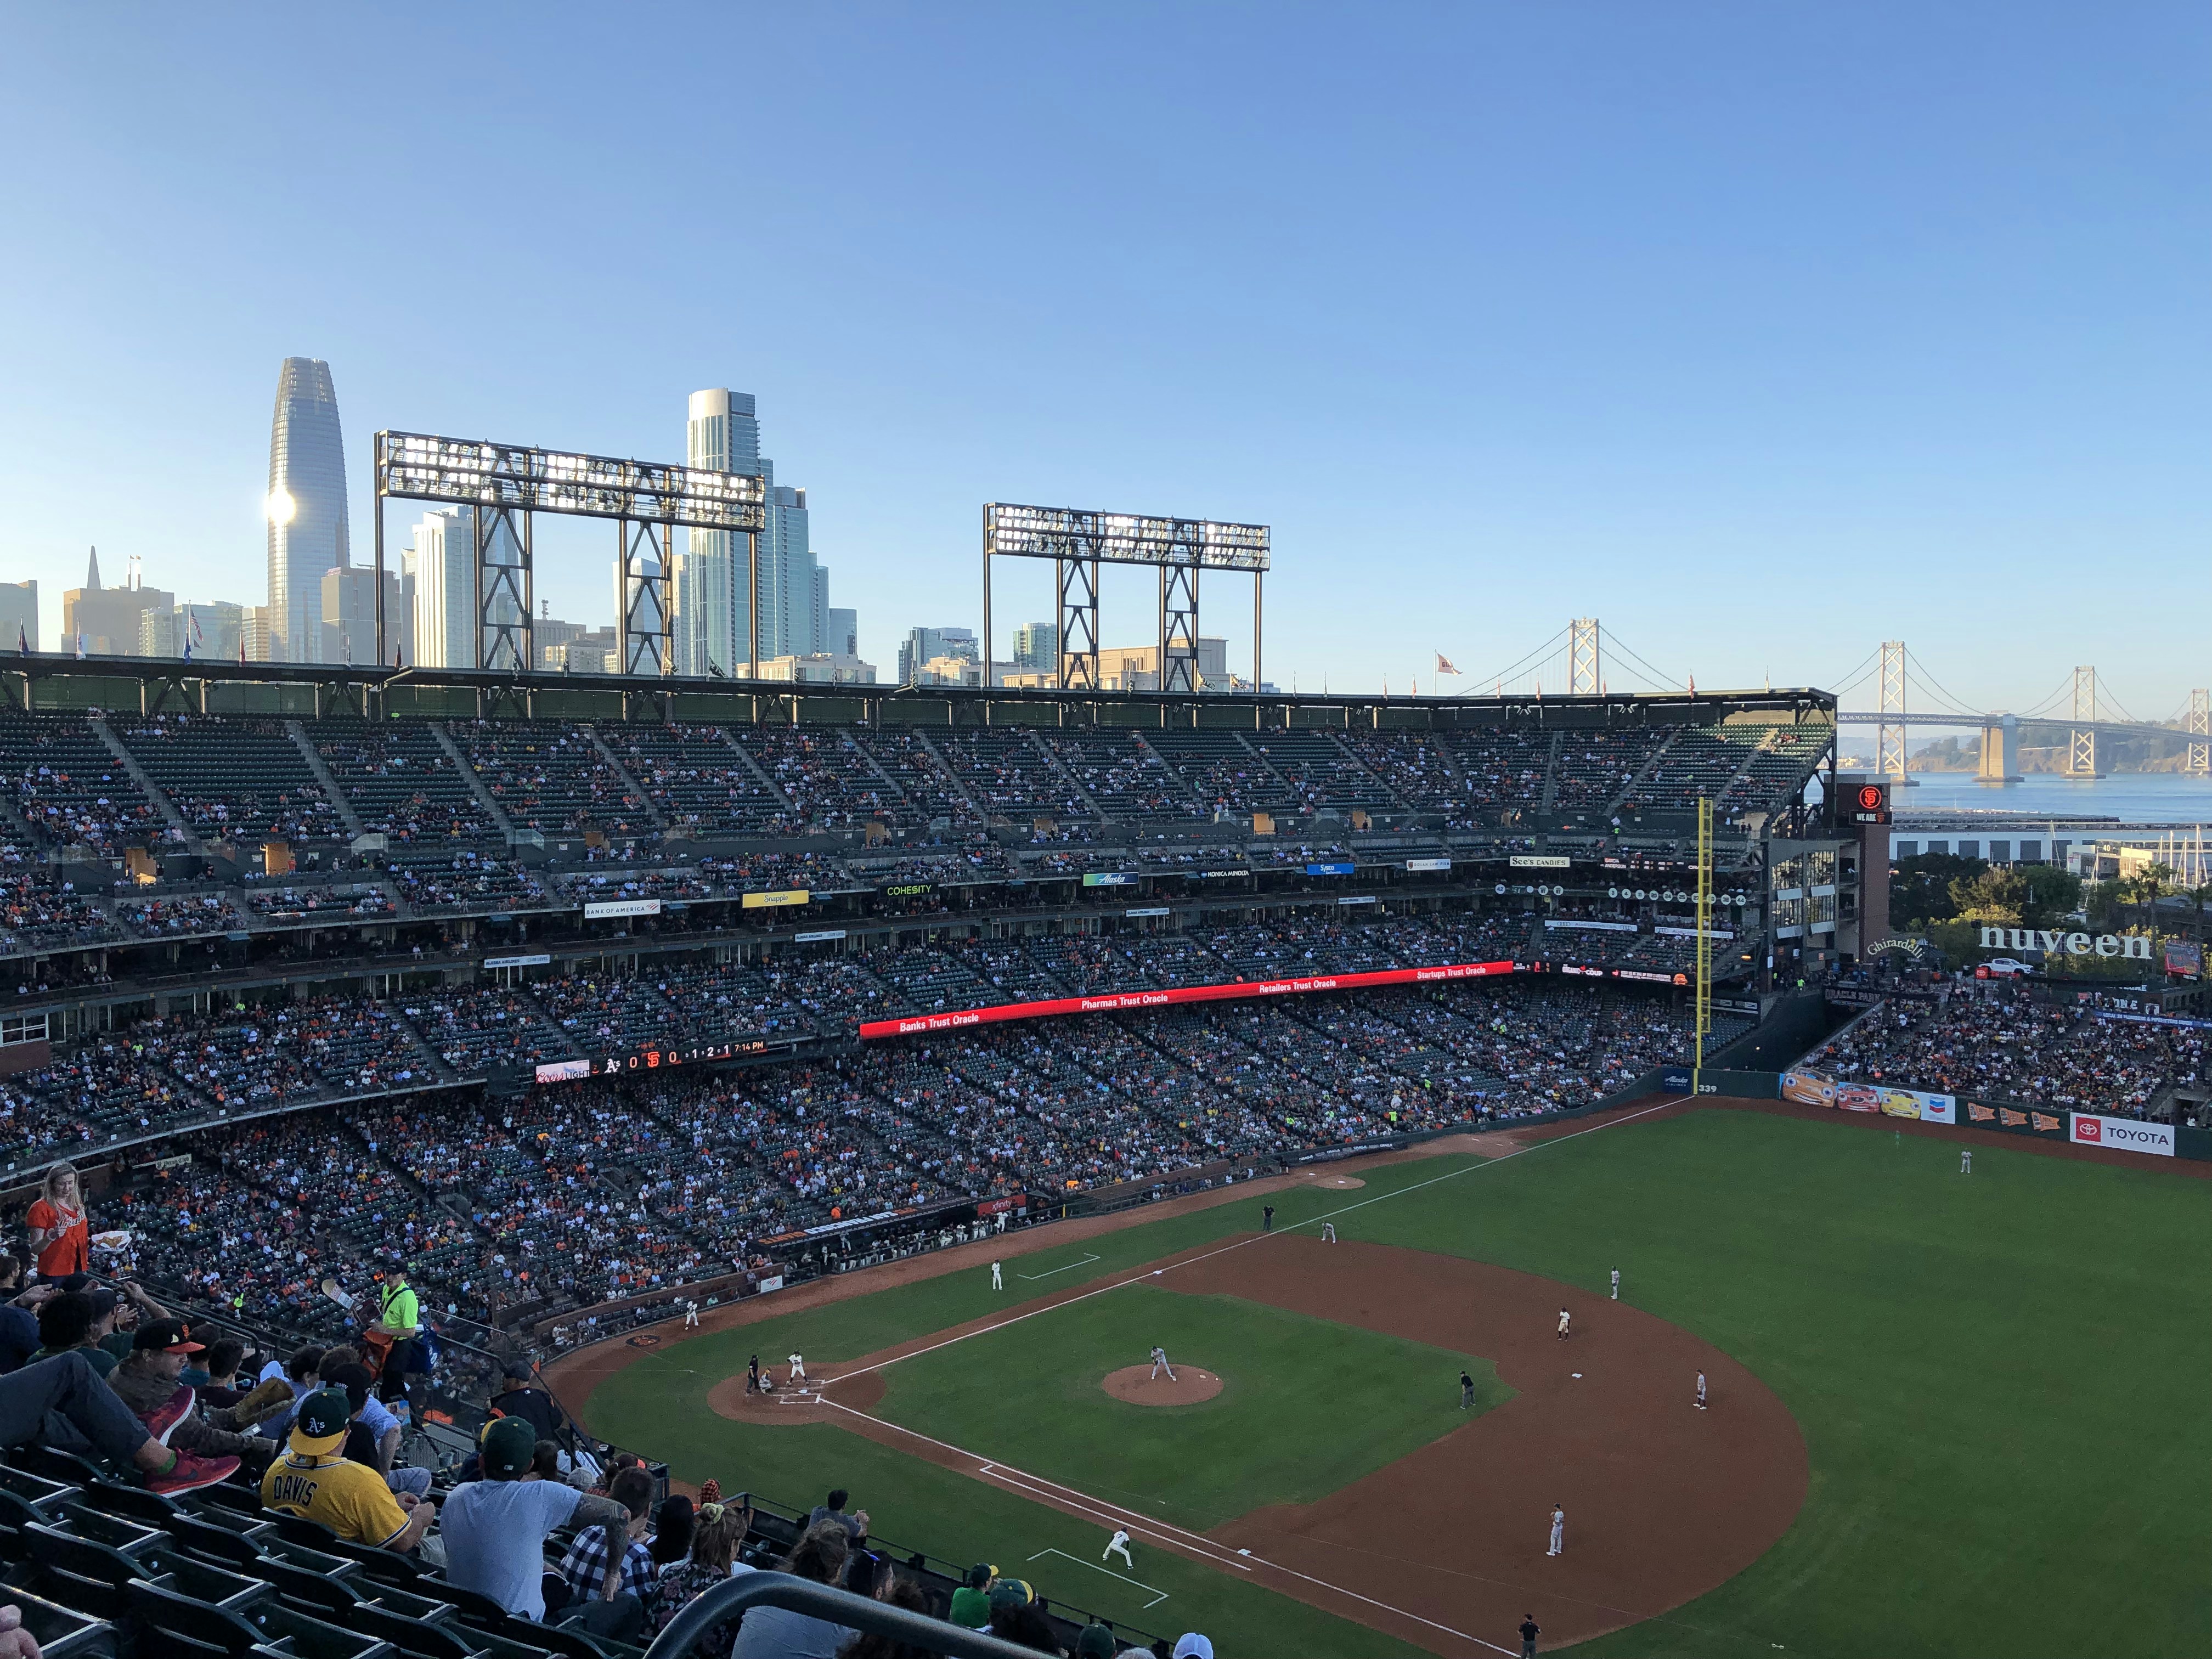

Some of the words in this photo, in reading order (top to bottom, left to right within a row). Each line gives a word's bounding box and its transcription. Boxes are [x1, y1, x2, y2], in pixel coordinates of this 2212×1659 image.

[1857, 813, 1865, 821] WE
[1865, 813, 1877, 821] ARE
[1512, 857, 1534, 865] See's
[1098, 874, 1126, 884] Alaska
[887, 884, 932, 895] COHESITY
[764, 894, 789, 904] Snapple
[1867, 938, 1925, 959] Ghirardelli
[1979, 927, 2153, 960] nuveen
[1417, 969, 1446, 980] Startups
[1447, 967, 1465, 977] Trust
[1465, 966, 1486, 975] Oracle
[1259, 983, 1291, 994] Retailers
[1293, 981, 1312, 991] Trust
[1313, 978, 1336, 989] Oracle
[1081, 998, 1118, 1009] Pharmas
[1119, 997, 1141, 1007] Trust
[1142, 994, 1169, 1004] Oracle
[900, 1020, 926, 1032] Banks
[928, 1017, 950, 1029] Trust
[952, 1012, 979, 1025] Oracle
[692, 1048, 697, 1059] 1
[707, 1046, 714, 1057] 2
[724, 1044, 729, 1054] 1
[734, 1042, 751, 1053] 7:14
[752, 1041, 764, 1050] PM
[669, 1051, 677, 1063] 0
[604, 1058, 621, 1074] A's
[629, 1056, 637, 1068] 0
[565, 1069, 590, 1080] LIGHT
[1664, 1075, 1688, 1084] Alaska
[2107, 1127, 2169, 1146] TOYOTA
[992, 1199, 1012, 1211] xfinity
[306, 1417, 325, 1434] A's
[274, 1474, 318, 1508] DAVIS
